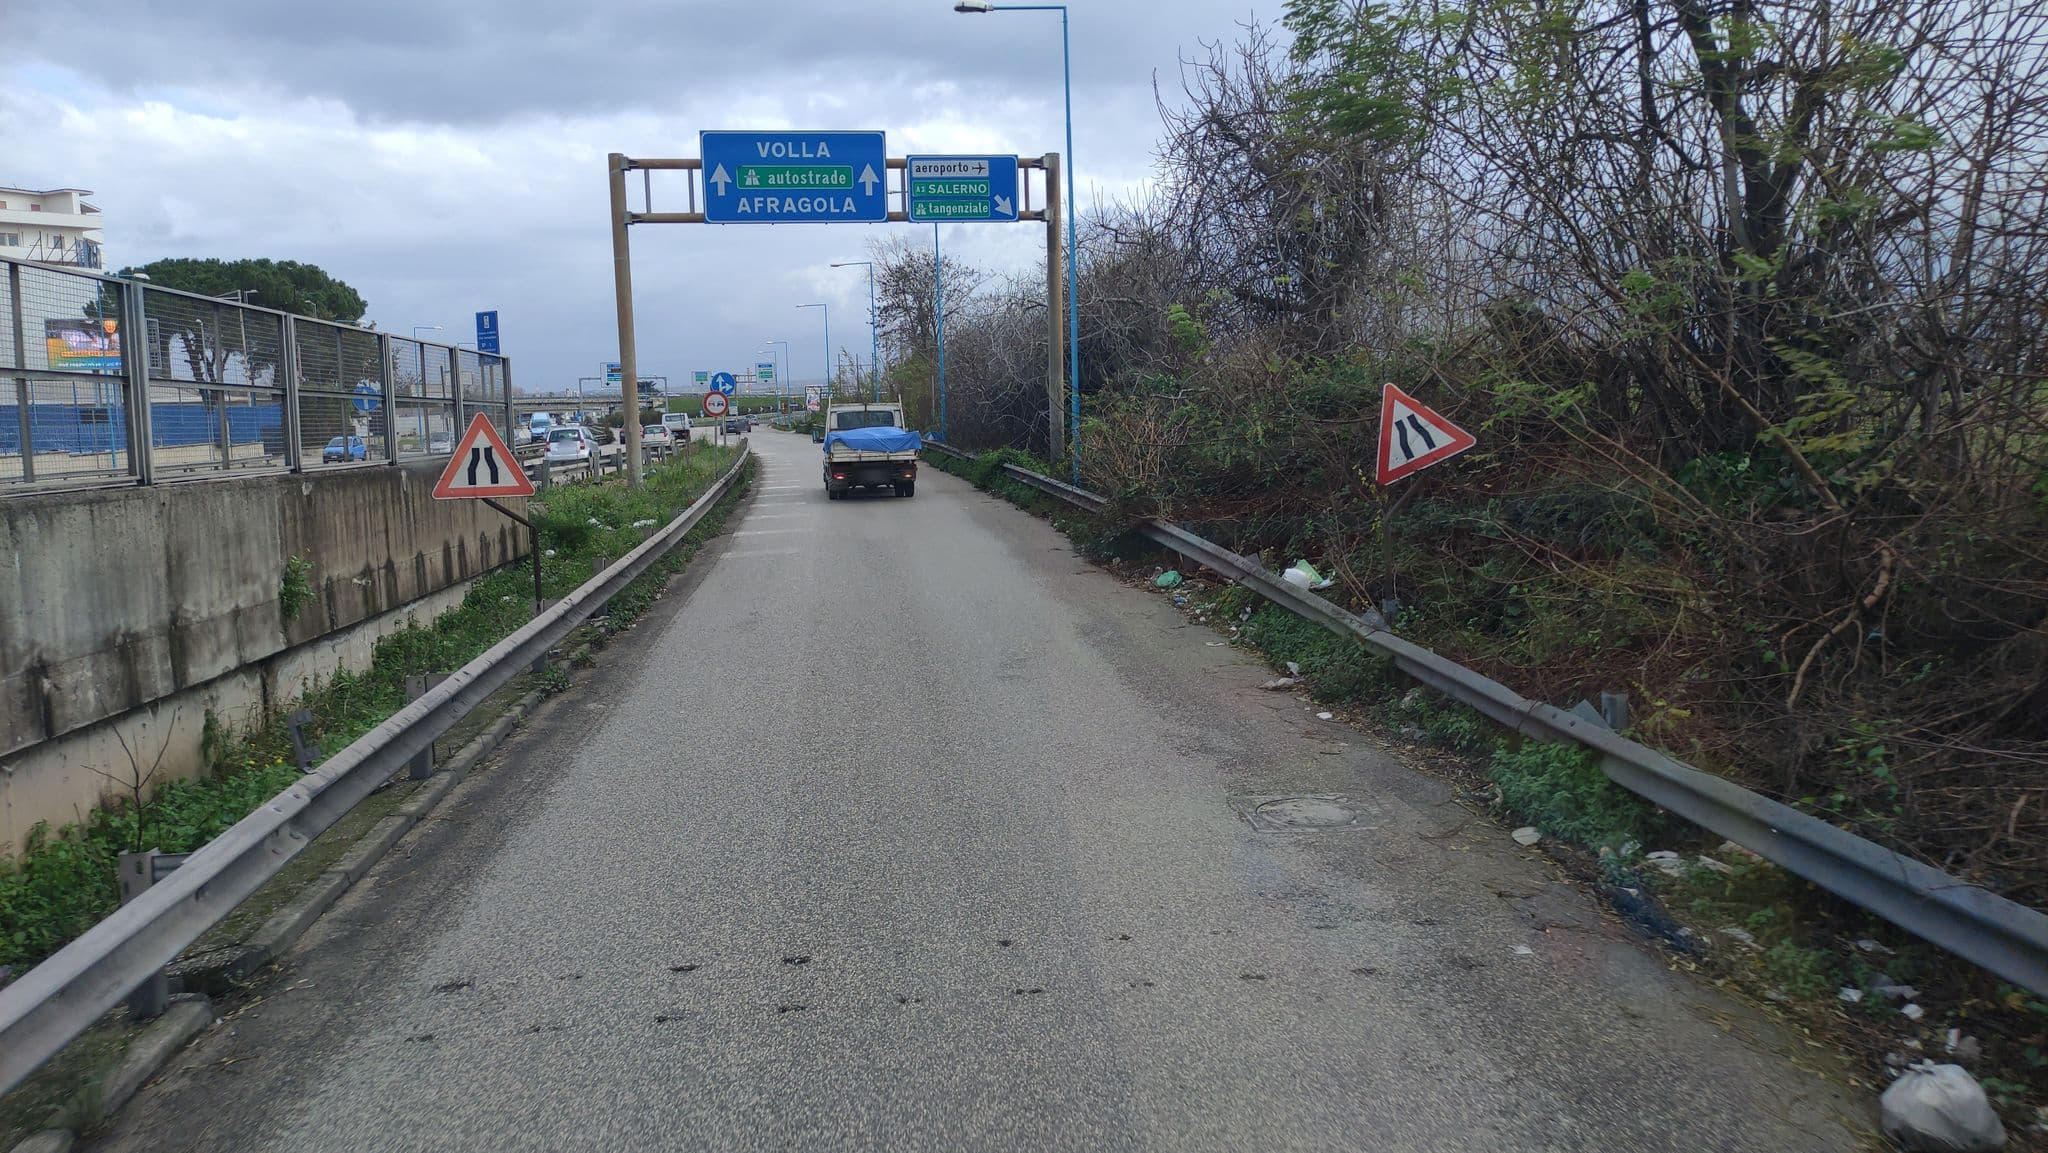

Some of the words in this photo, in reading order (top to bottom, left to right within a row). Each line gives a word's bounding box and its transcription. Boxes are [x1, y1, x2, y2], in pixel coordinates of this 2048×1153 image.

[757, 142, 831, 158] VOLLA
[915, 162, 969, 175] aeroporto
[768, 169, 847, 185] autostrade
[928, 184, 987, 194] SALERNO
[737, 197, 856, 213] AFRAGOLA
[929, 203, 989, 215] tangenziale
